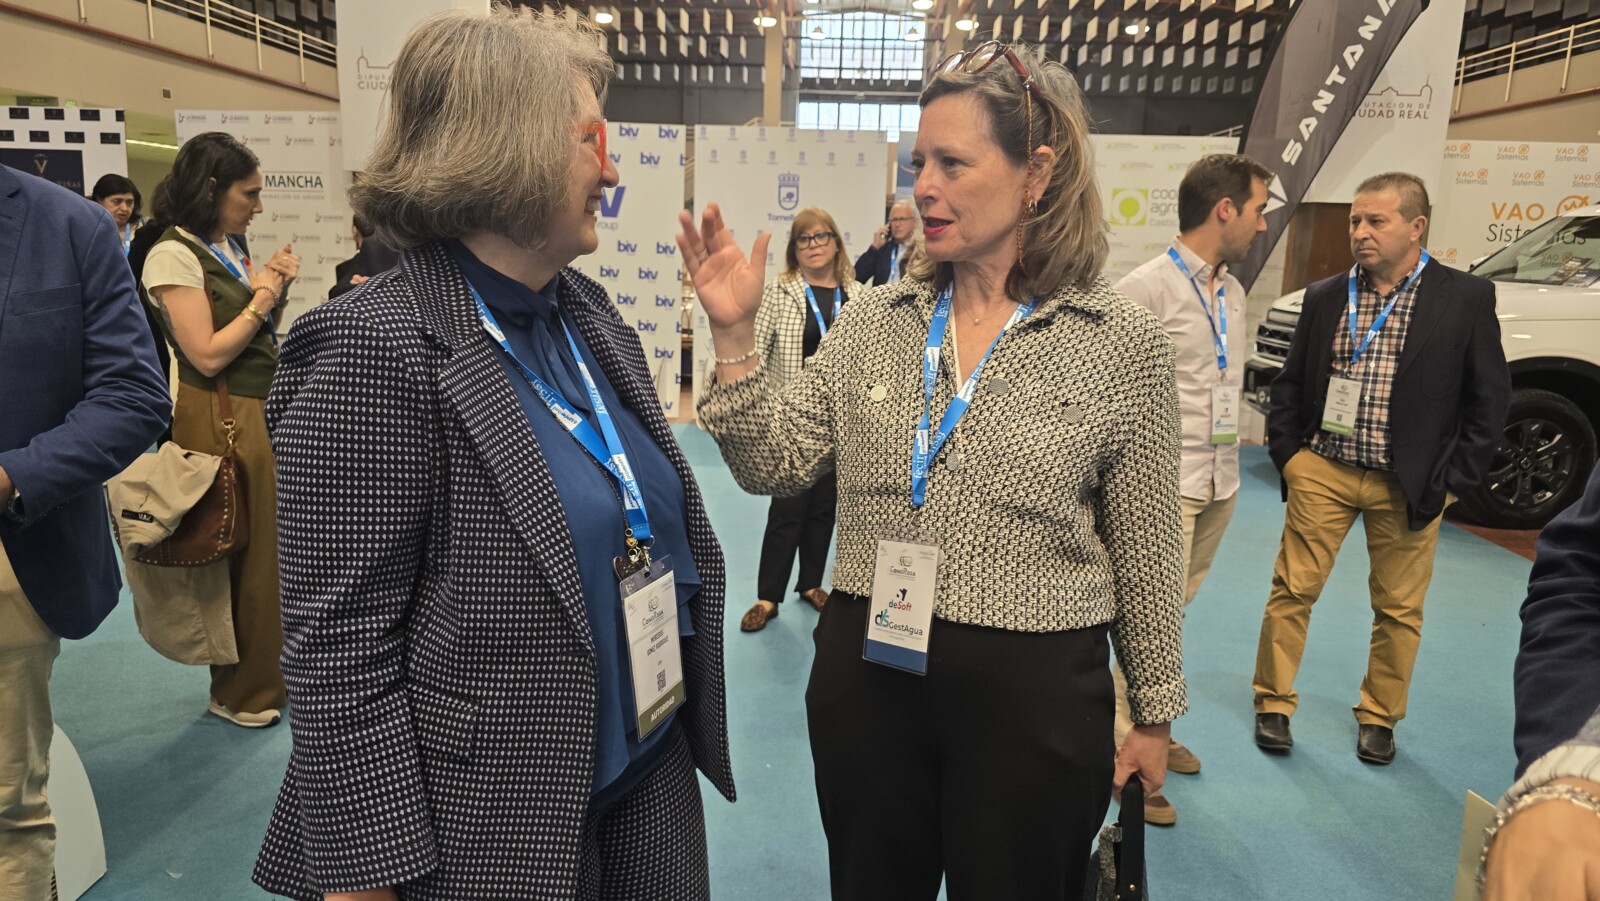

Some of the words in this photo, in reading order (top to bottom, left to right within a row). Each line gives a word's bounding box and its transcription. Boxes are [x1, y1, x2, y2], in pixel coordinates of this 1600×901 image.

[1281, 0, 1396, 166] SANTANA
[1355, 109, 1395, 118] UDAD
[1399, 110, 1429, 119] REAL
[619, 124, 639, 137] biv
[658, 125, 678, 139] biv
[1496, 153, 1529, 161] Sistemas
[1556, 147, 1574, 155] VAO
[640, 152, 660, 165] biv
[1555, 155, 1588, 163] Sistemas
[1456, 170, 1474, 178] VAO
[1513, 171, 1531, 179] VAO
[265, 175, 324, 188] MANCHA
[1511, 179, 1544, 187] Sistemas
[1491, 202, 1545, 221] VAO
[617, 240, 637, 253] biv
[656, 242, 676, 255] biv
[600, 265, 620, 278] biv
[638, 267, 658, 280] biv
[617, 292, 637, 305] biv
[655, 294, 675, 307] biv
[638, 320, 657, 332] biv
[654, 347, 674, 359] biv
[888, 600, 912, 612] deSoft
